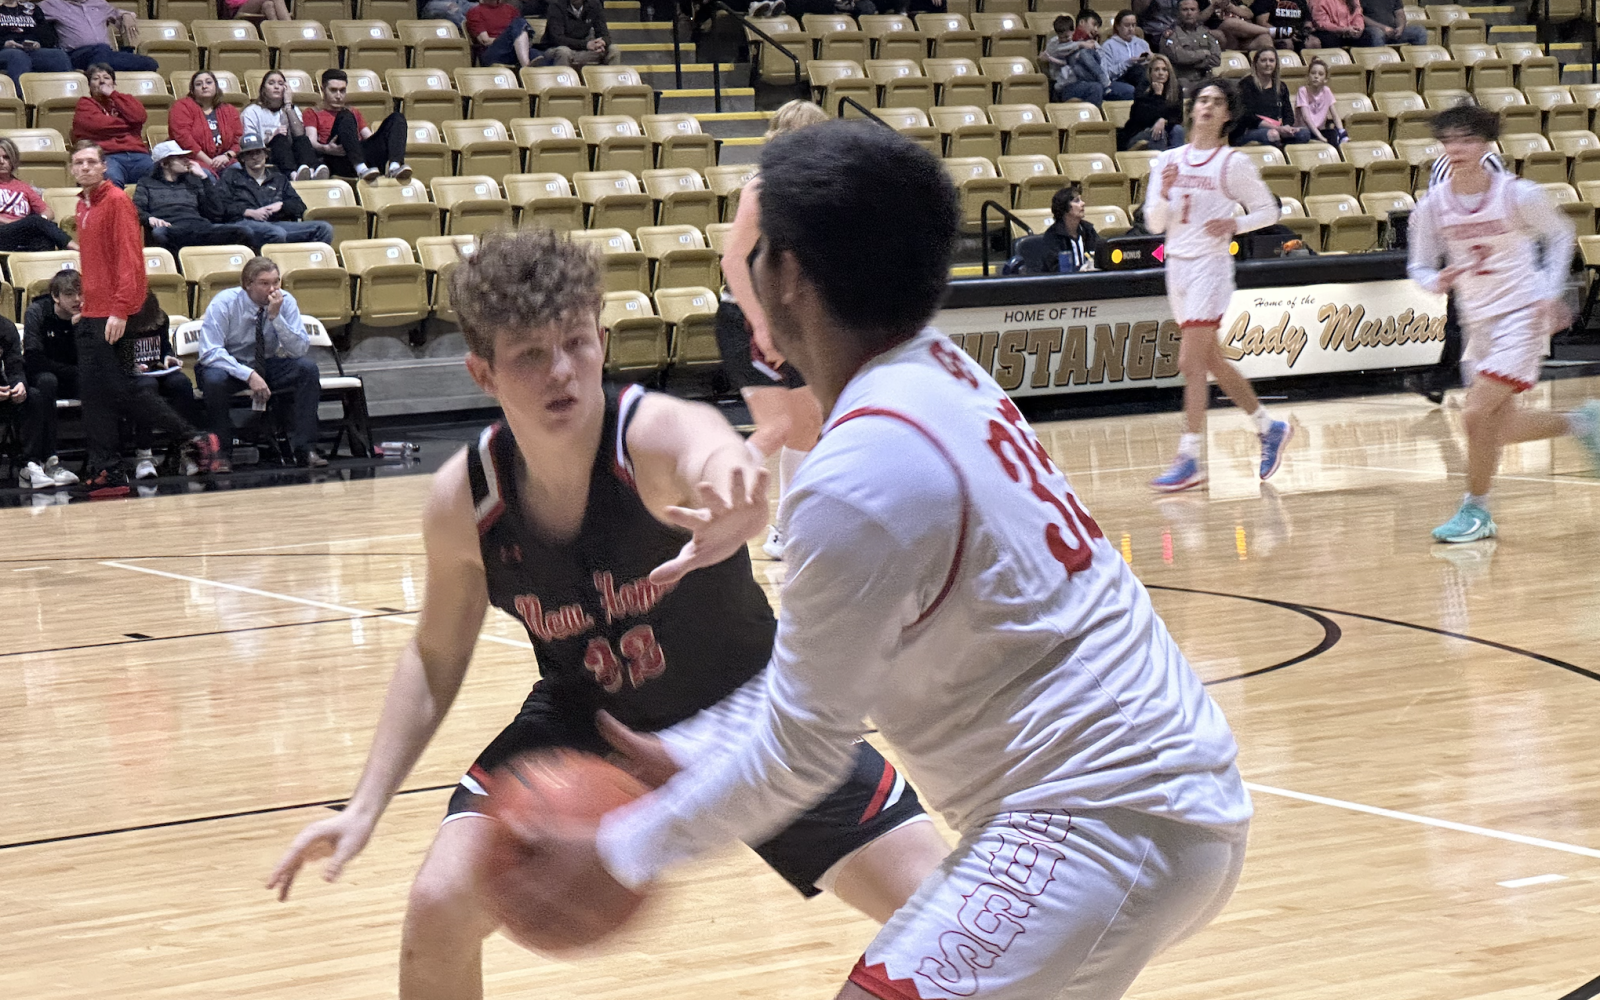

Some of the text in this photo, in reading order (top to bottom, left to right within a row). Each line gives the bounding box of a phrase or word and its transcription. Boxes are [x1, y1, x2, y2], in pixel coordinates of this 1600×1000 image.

[1180, 193, 1191, 225] 1
[1123, 251, 1141, 260] BONUS
[1253, 295, 1316, 308] Home of the
[1004, 306, 1097, 323] HOME OF THE
[1221, 311, 1307, 368] Lady
